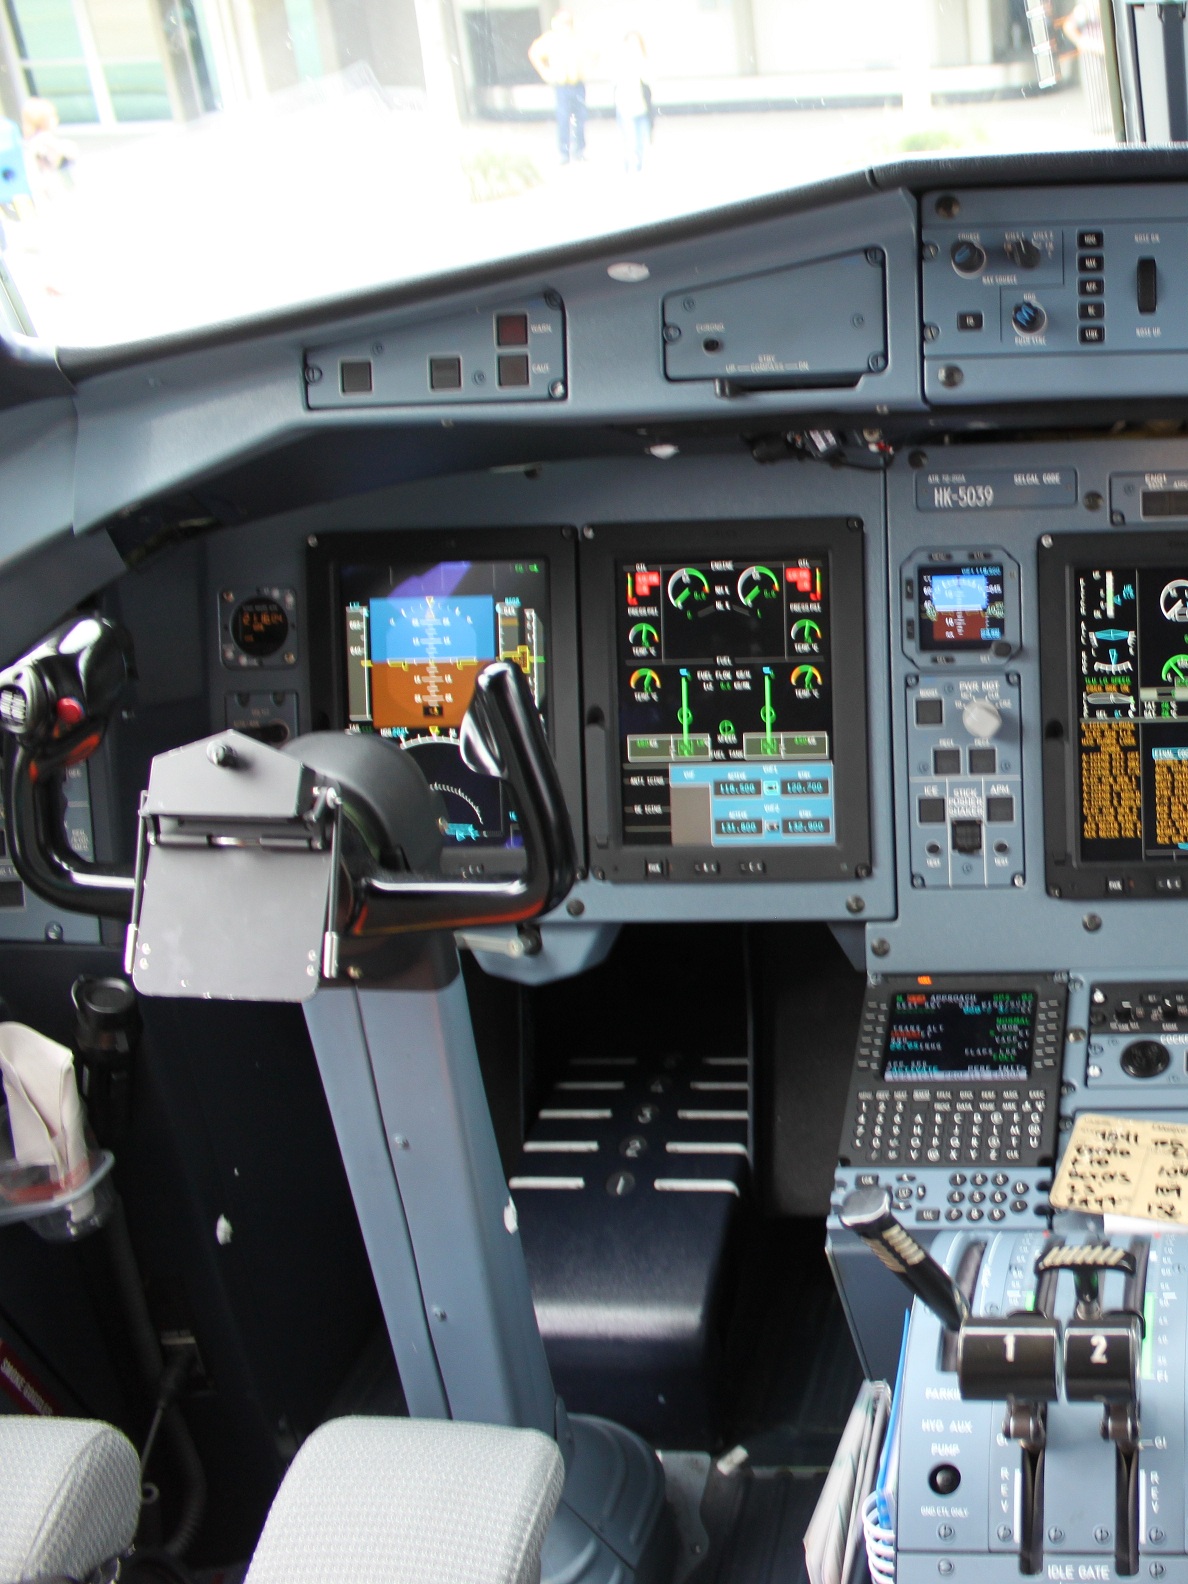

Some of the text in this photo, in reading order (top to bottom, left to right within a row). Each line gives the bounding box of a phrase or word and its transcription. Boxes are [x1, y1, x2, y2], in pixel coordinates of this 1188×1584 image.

[1043, 472, 1062, 485] CODE
[934, 485, 994, 508] HK-5039
[1003, 1334, 1015, 1362] 1
[1090, 1335, 1108, 1364] 2
[949, 1420, 973, 1433] AUX
[931, 1442, 960, 1456] PUMP
[1048, 1564, 1110, 1581] IDLE GATE
